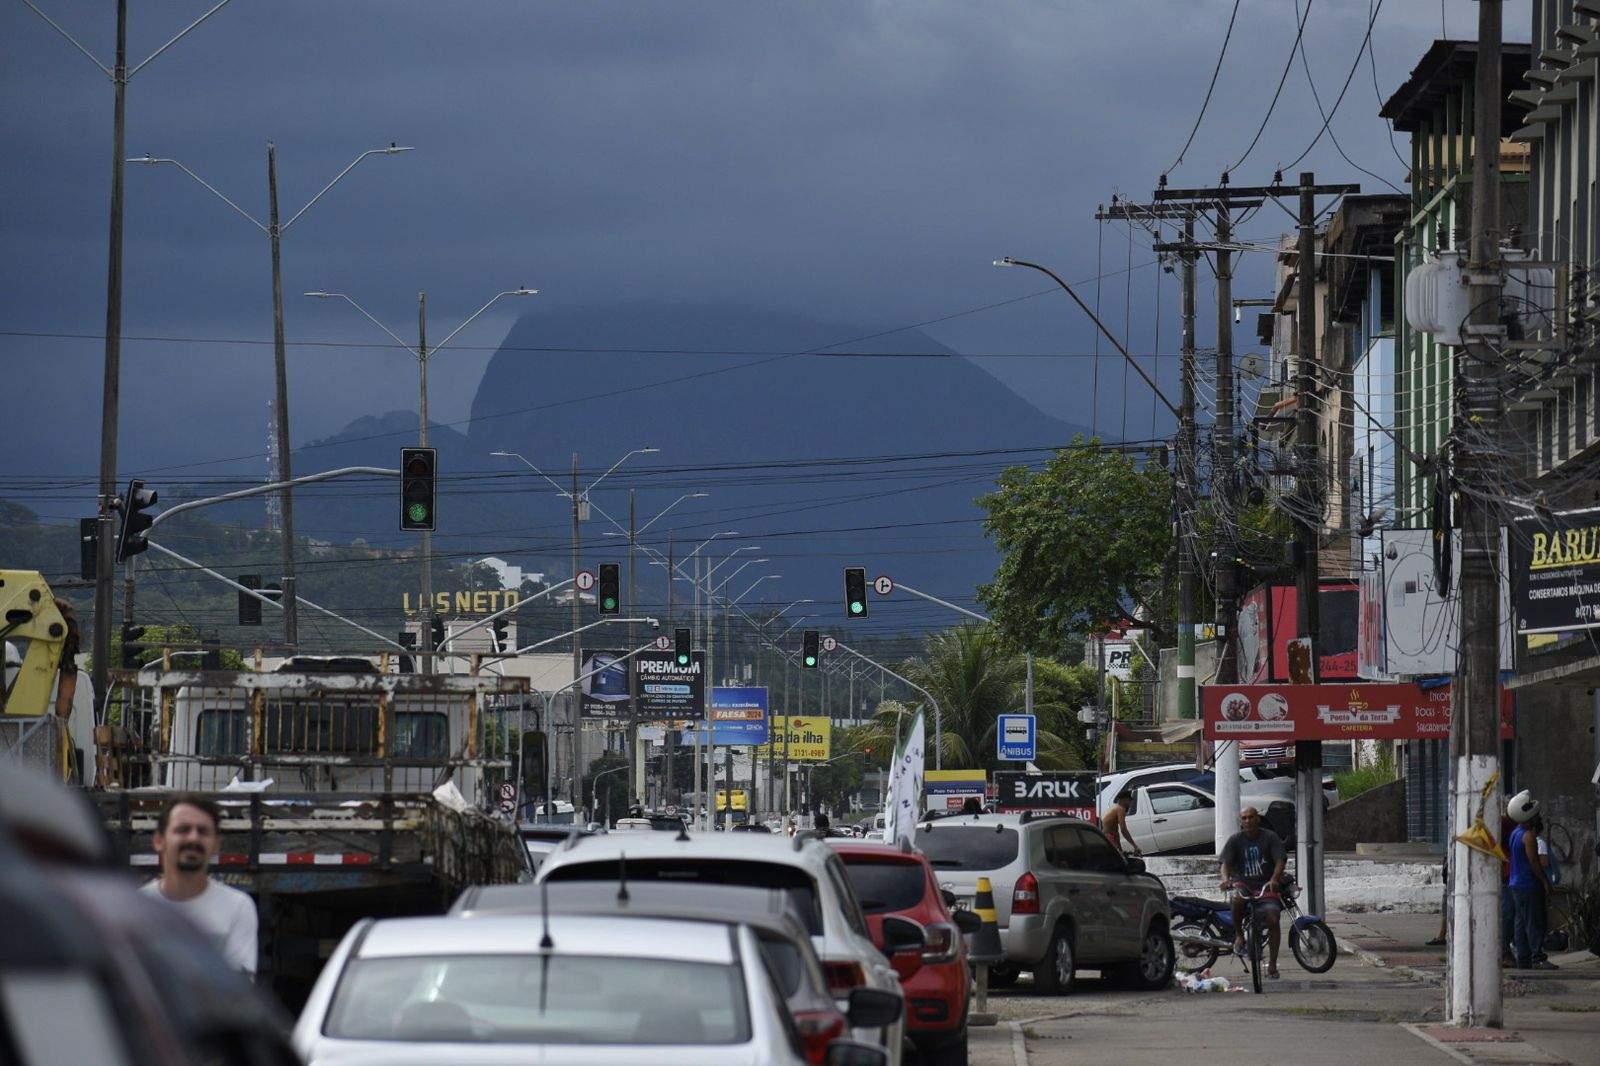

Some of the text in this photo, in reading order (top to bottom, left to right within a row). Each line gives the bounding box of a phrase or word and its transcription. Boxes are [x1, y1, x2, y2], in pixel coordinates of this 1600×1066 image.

[1528, 586, 1569, 600] CONSERTAMOS
[403, 590, 519, 615] LS NETO
[803, 731, 824, 744] ilha
[1001, 745, 1032, 756] ÔNIBUS
[1014, 781, 1080, 798] BARUK
